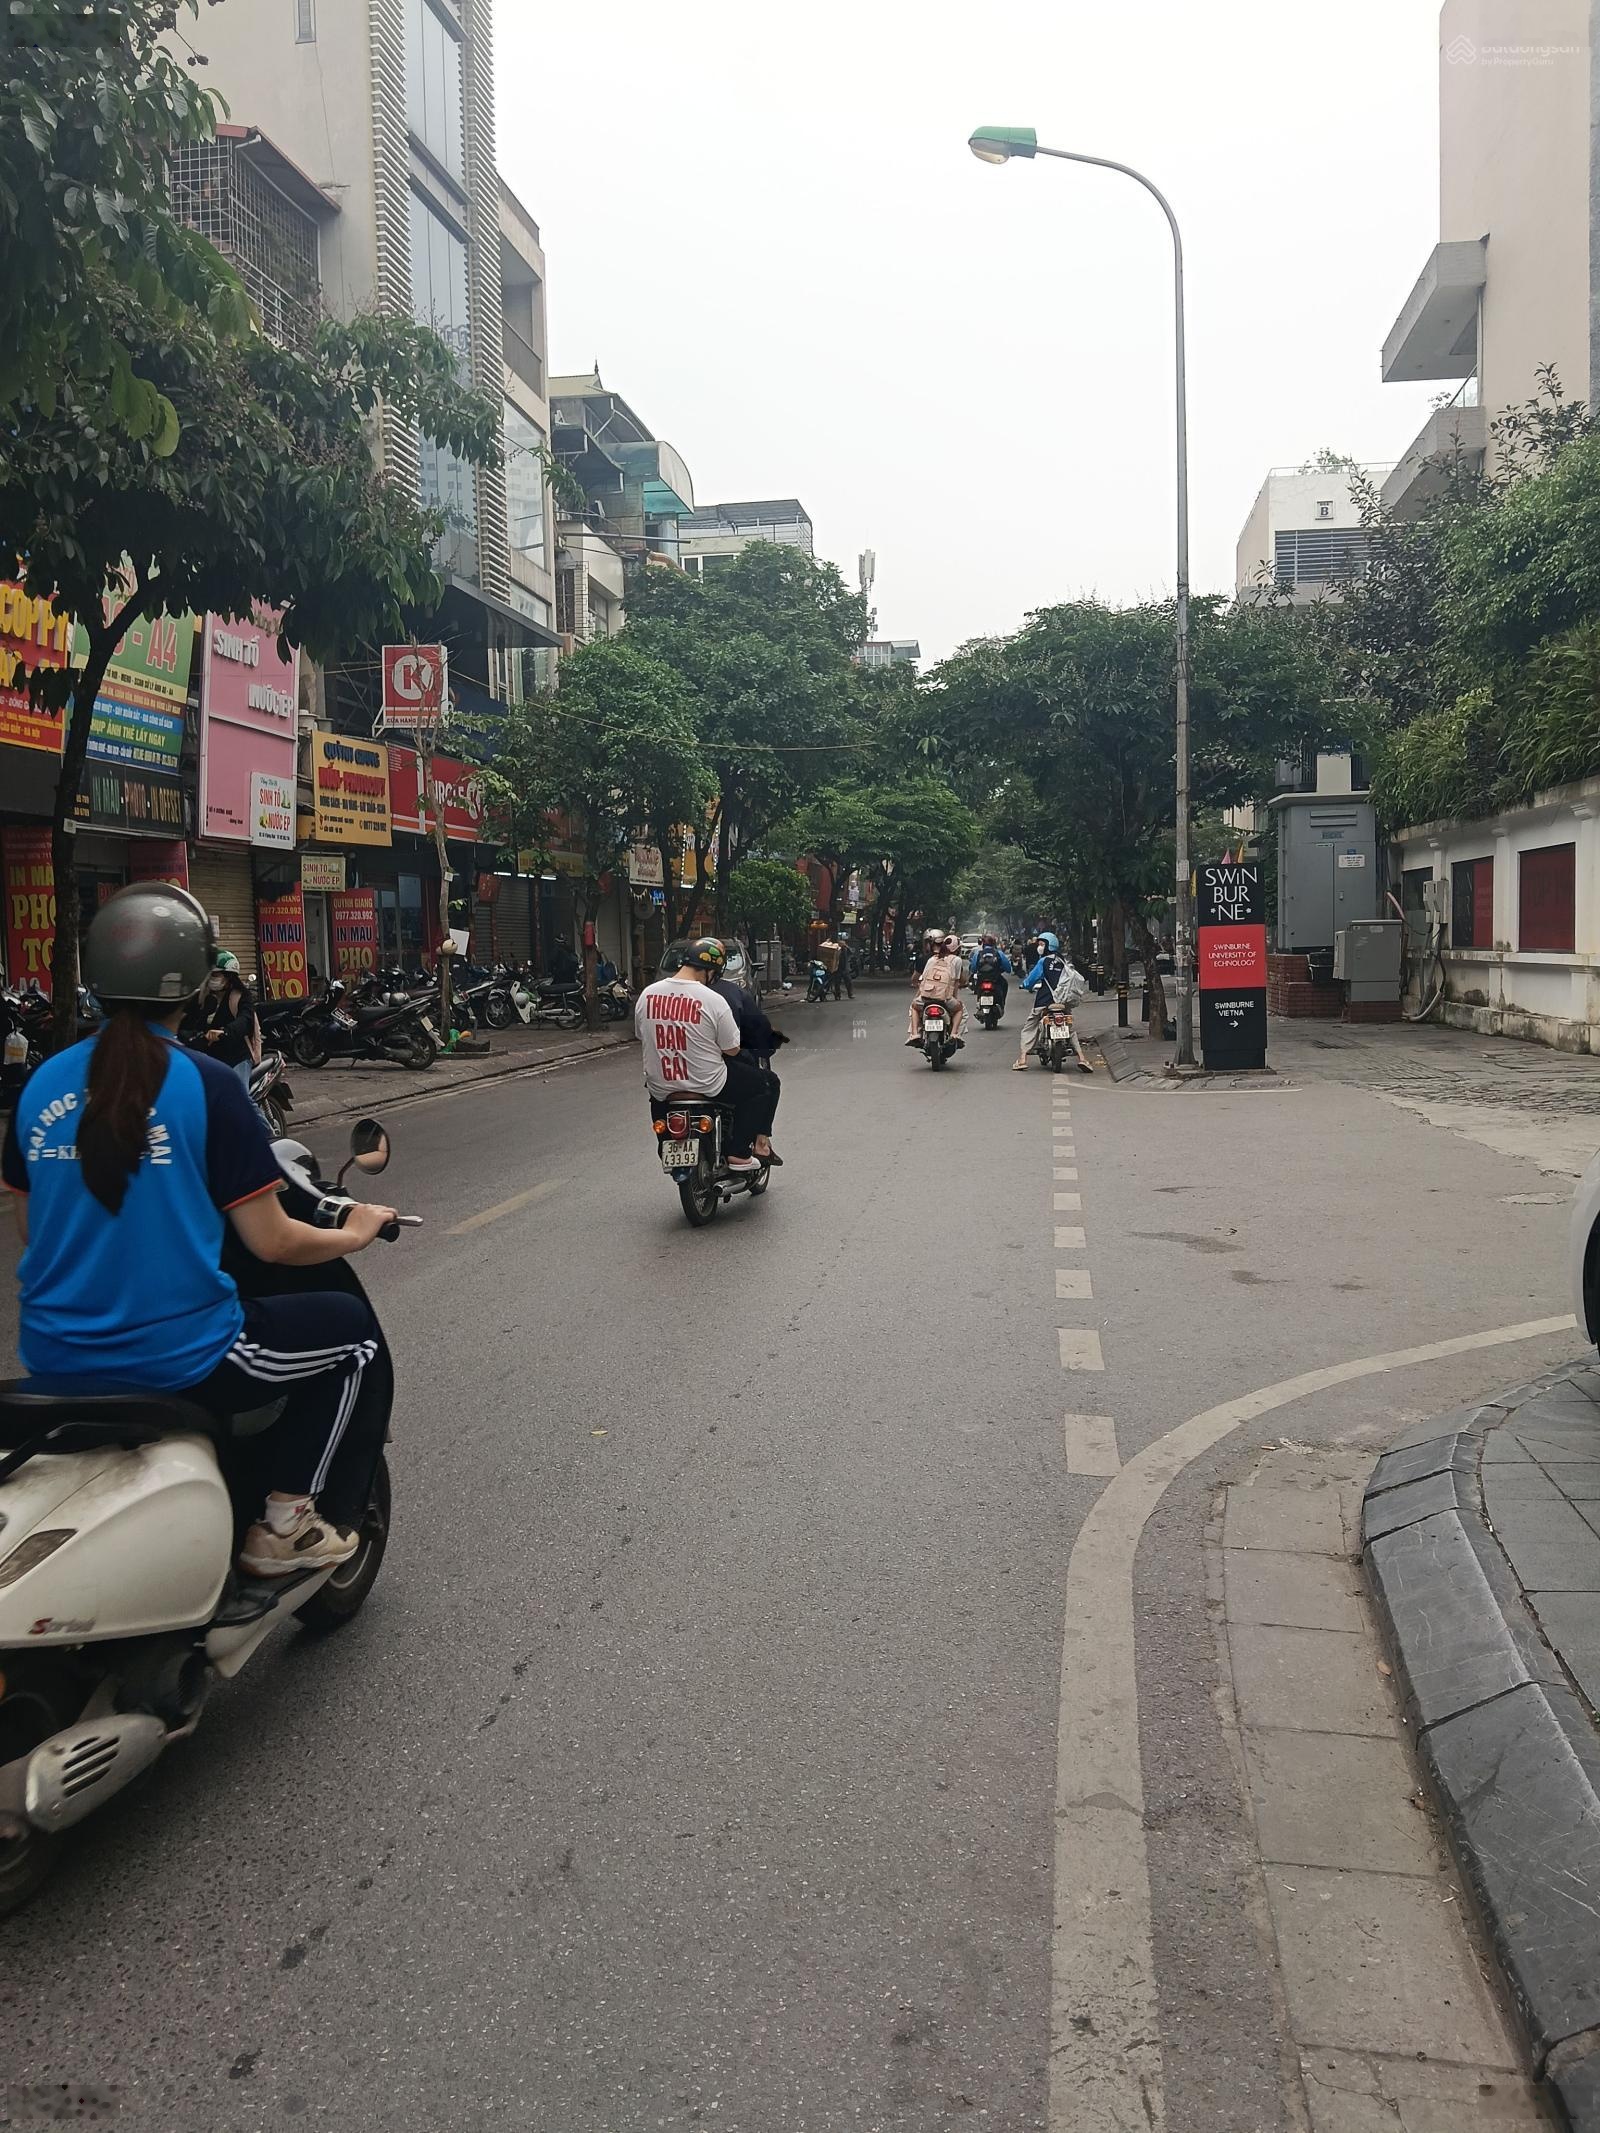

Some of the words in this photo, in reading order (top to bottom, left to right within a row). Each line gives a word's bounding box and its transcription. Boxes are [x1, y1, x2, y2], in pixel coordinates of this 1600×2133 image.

[1320, 506, 1329, 516] B
[146, 617, 177, 673] A4
[213, 629, 243, 663] SINH
[148, 732, 166, 747] NGAY
[92, 776, 101, 812] IN
[150, 785, 159, 820] IN
[159, 786, 181, 823] OFFSET
[259, 788, 272, 805] SINH
[274, 788, 280, 807] TỐ
[268, 811, 282, 830] NƯỚC
[283, 813, 291, 831] ÉP
[9, 865, 26, 885] IN
[303, 863, 319, 873] SINH
[354, 897, 373, 908] GIANG
[1213, 885, 1250, 903] BUR
[1218, 903, 1245, 920] NE
[262, 923, 273, 942] IN
[336, 926, 345, 941] IN
[1208, 951, 1246, 959] UNIVERSITY
[1213, 943, 1251, 951] SWINBURNE
[264, 950, 304, 972] PHO
[338, 947, 373, 970] PHO
[271, 979, 303, 1000] TO
[1214, 1001, 1254, 1010] SWINBURNE
[655, 1024, 687, 1051] BẠN
[661, 1052, 689, 1081] GÁI
[38, 1092, 79, 1128] HỌC
[664, 1153, 696, 1166] 433.93
